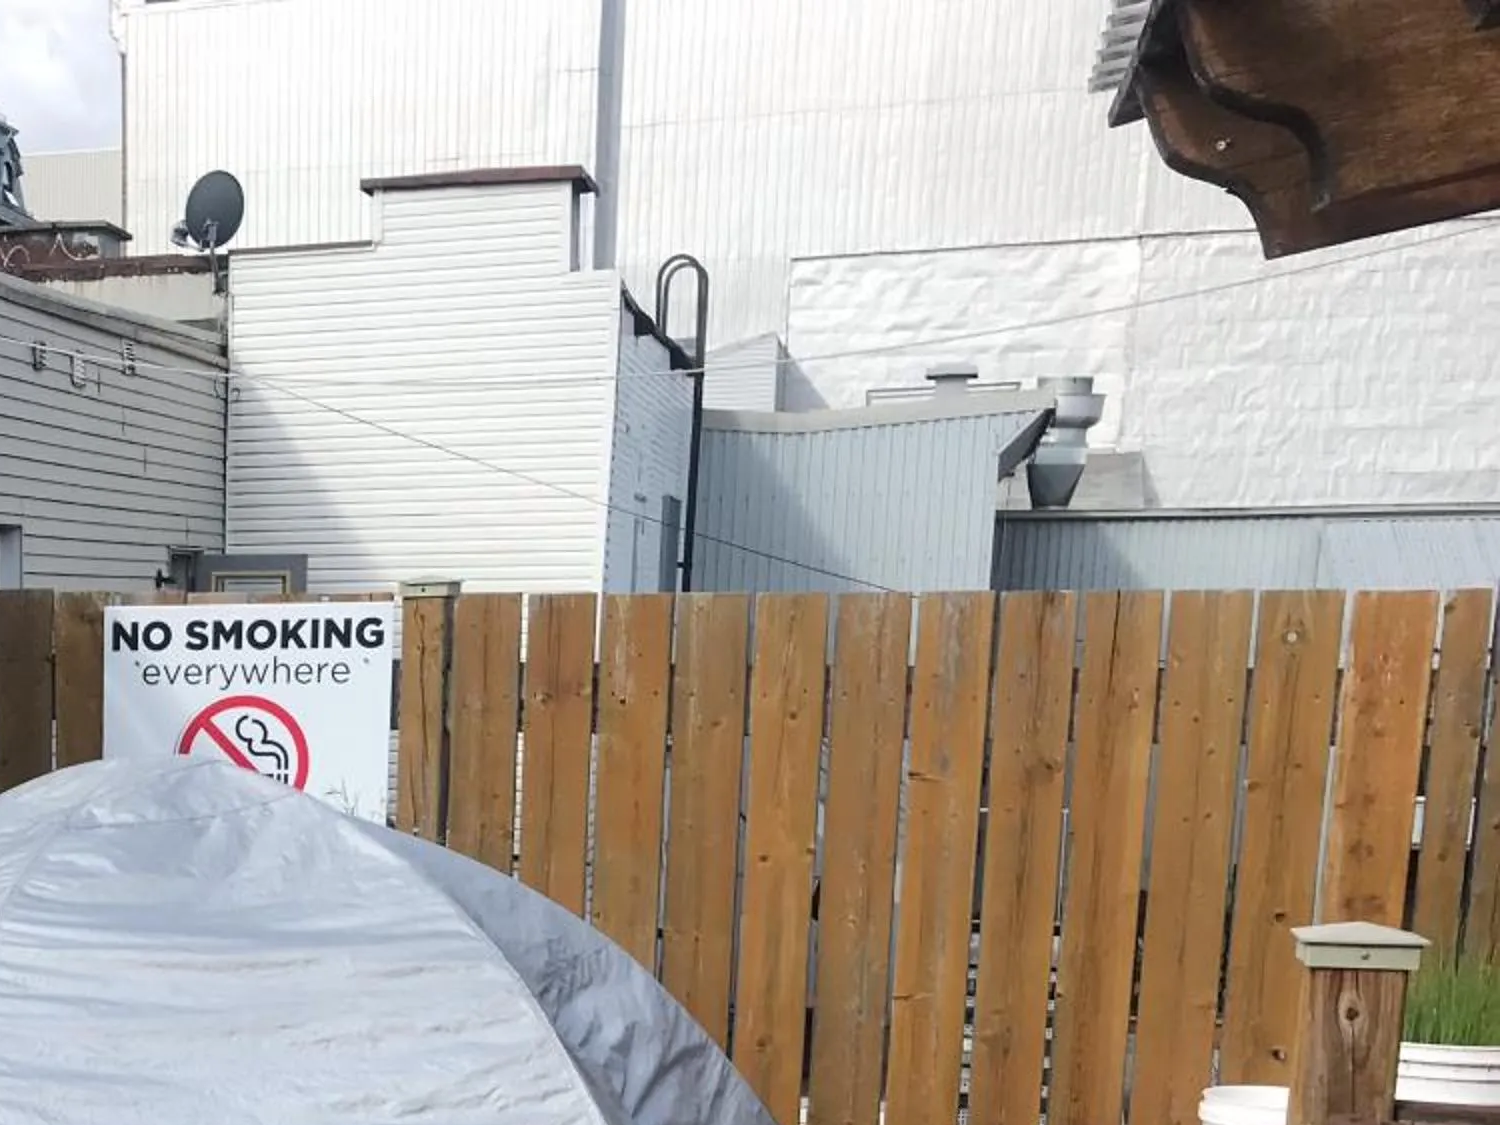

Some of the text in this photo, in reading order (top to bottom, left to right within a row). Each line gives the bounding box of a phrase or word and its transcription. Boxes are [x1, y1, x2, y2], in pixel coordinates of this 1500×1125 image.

[111, 617, 385, 651] NO SMOKING
[141, 656, 351, 690] everywhere
